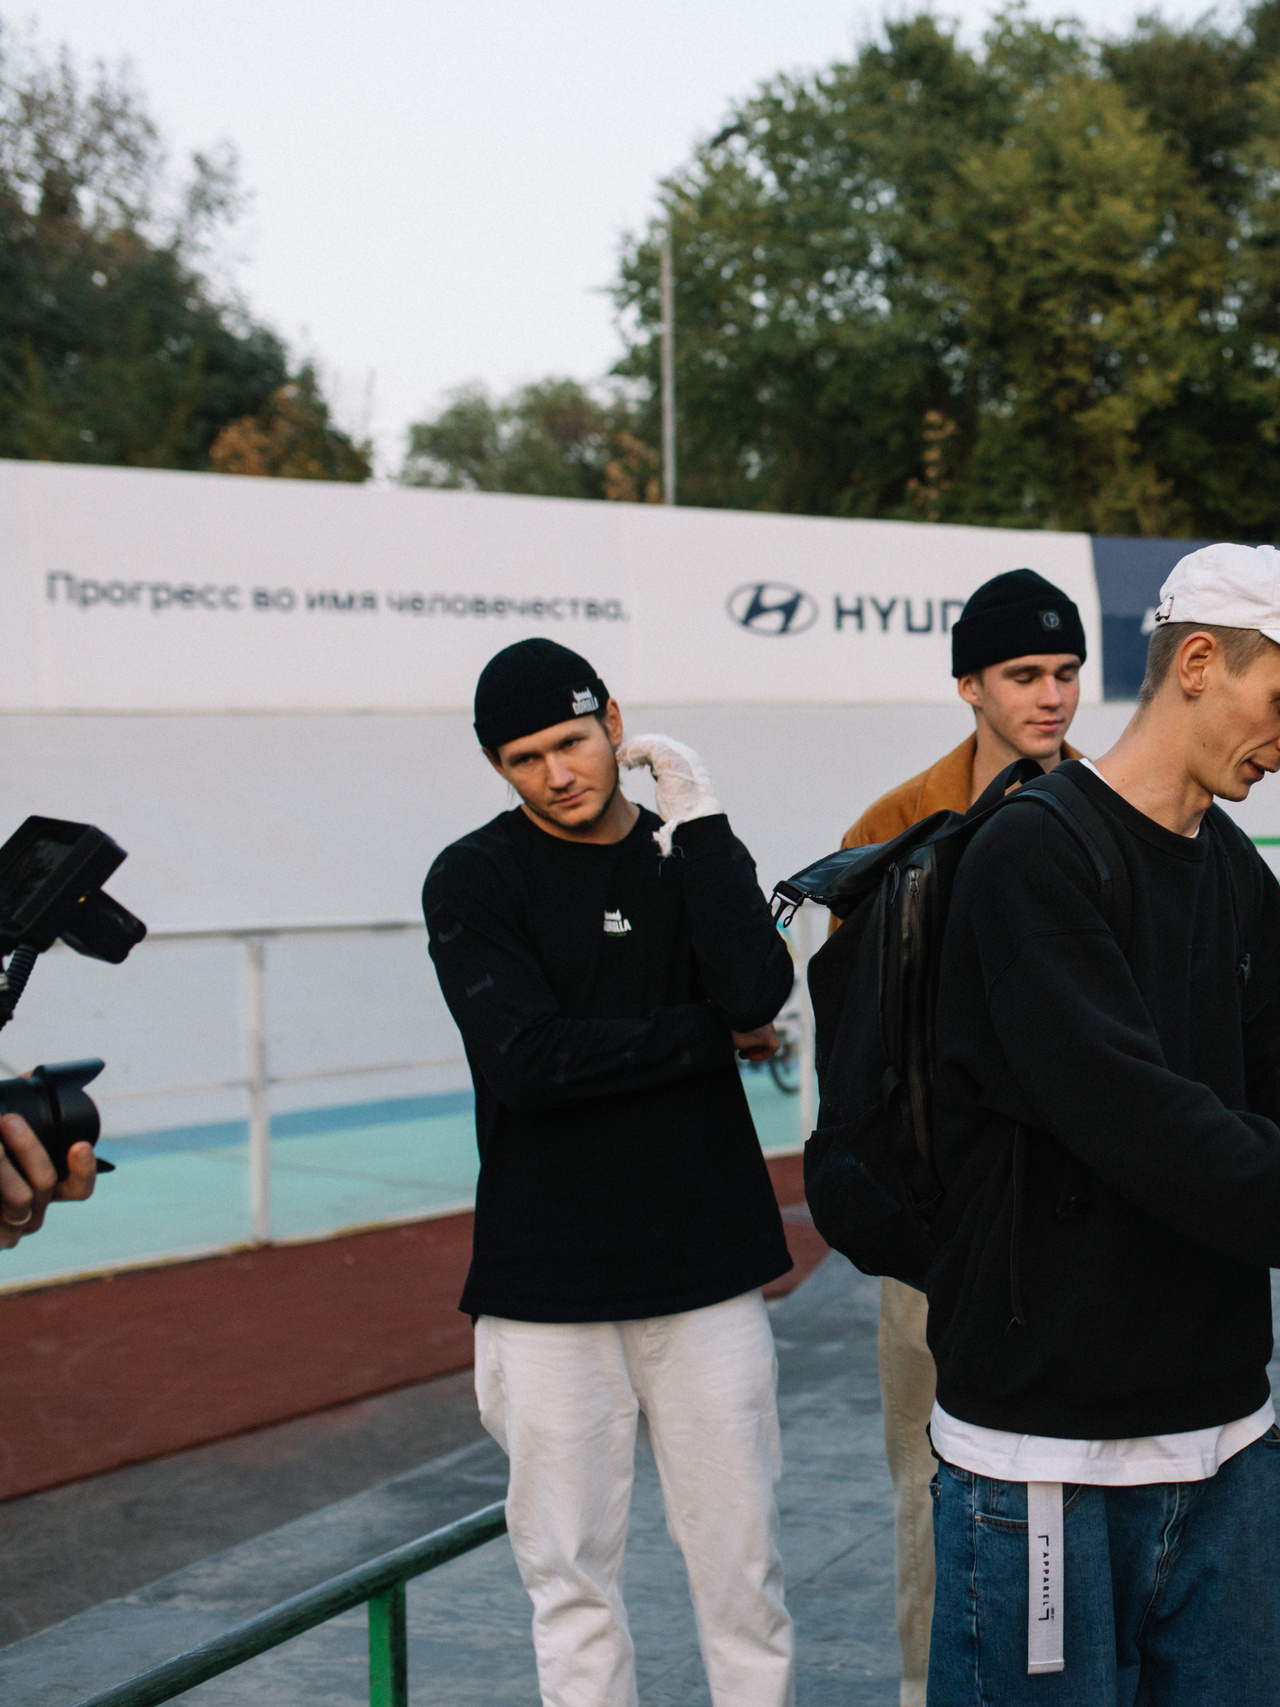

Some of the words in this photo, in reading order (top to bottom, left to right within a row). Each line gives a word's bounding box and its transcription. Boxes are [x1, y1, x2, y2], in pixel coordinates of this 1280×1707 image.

[46, 570, 242, 614] Прогресс
[252, 585, 296, 613] во
[304, 587, 378, 613] имя
[385, 592, 630, 622] человечества.
[1042, 1552, 1050, 1606] APPAREL
